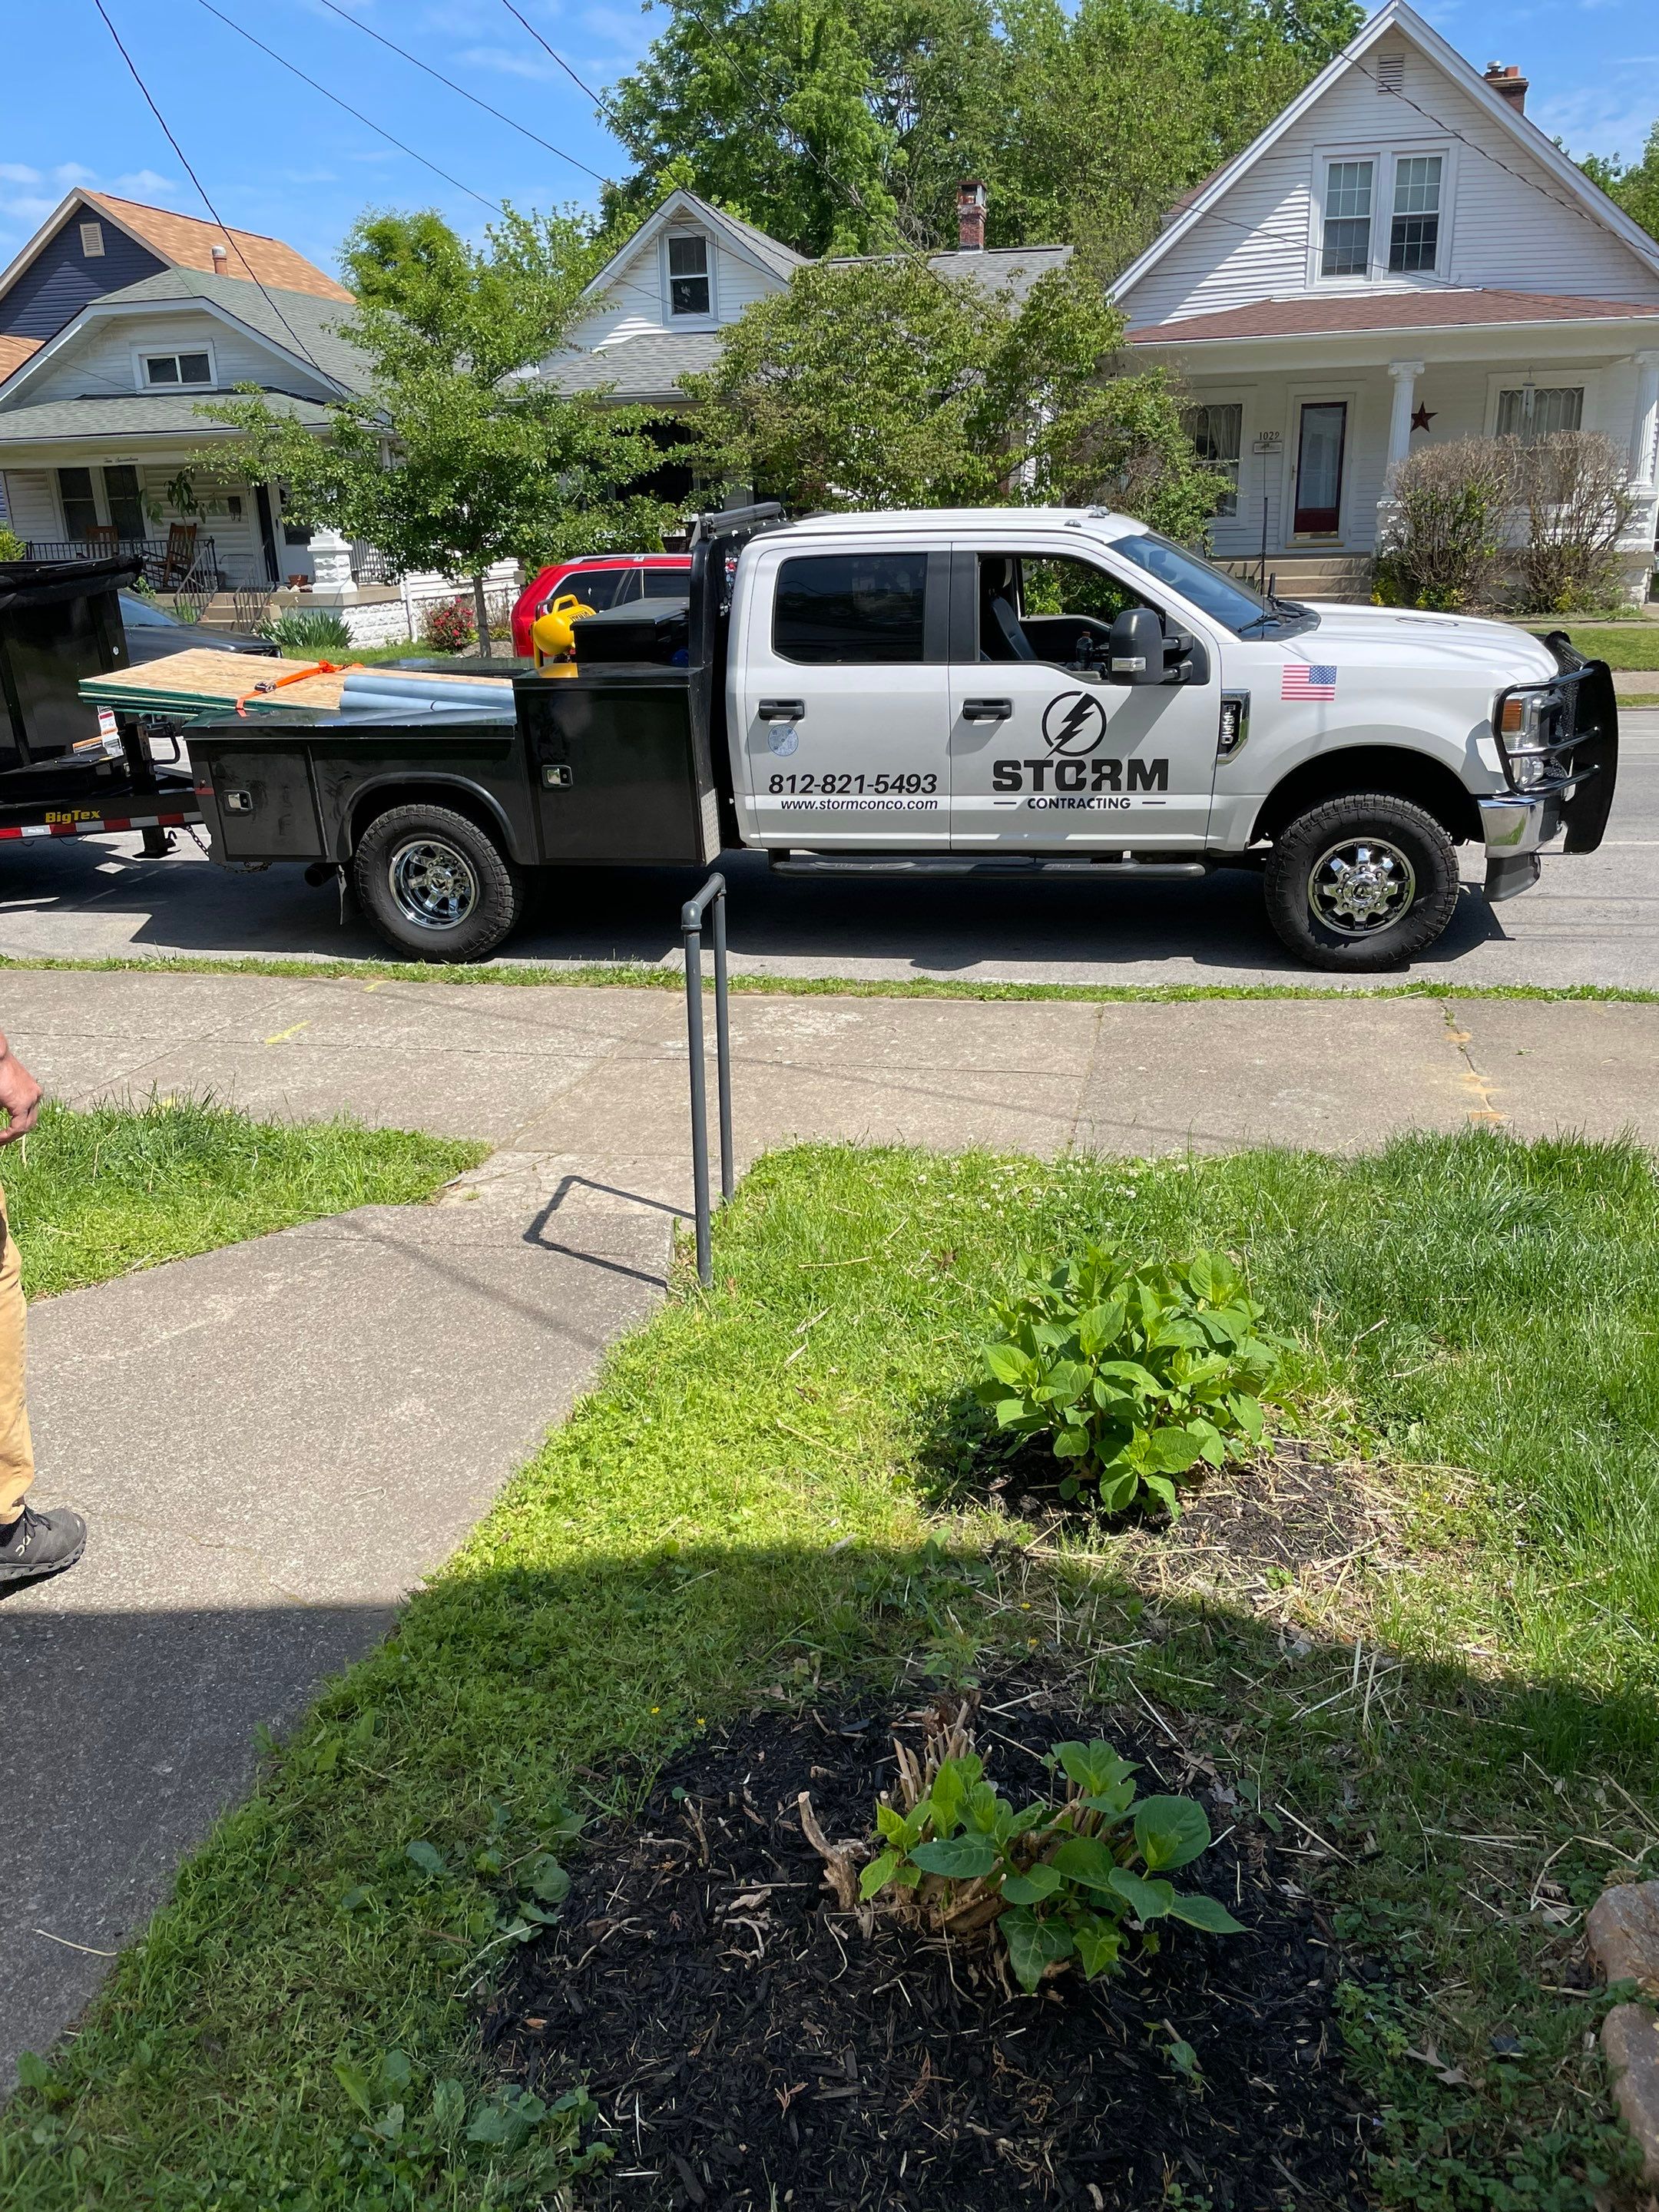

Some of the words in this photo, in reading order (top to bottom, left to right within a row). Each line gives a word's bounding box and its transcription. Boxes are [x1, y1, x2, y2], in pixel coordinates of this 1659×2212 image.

[1260, 431, 1280, 440] 1029
[992, 758, 1169, 792] STORM
[768, 773, 938, 794] 812-821-5493
[780, 798, 939, 810] www.stormconco.com
[1027, 797, 1131, 810] CONTRACTING
